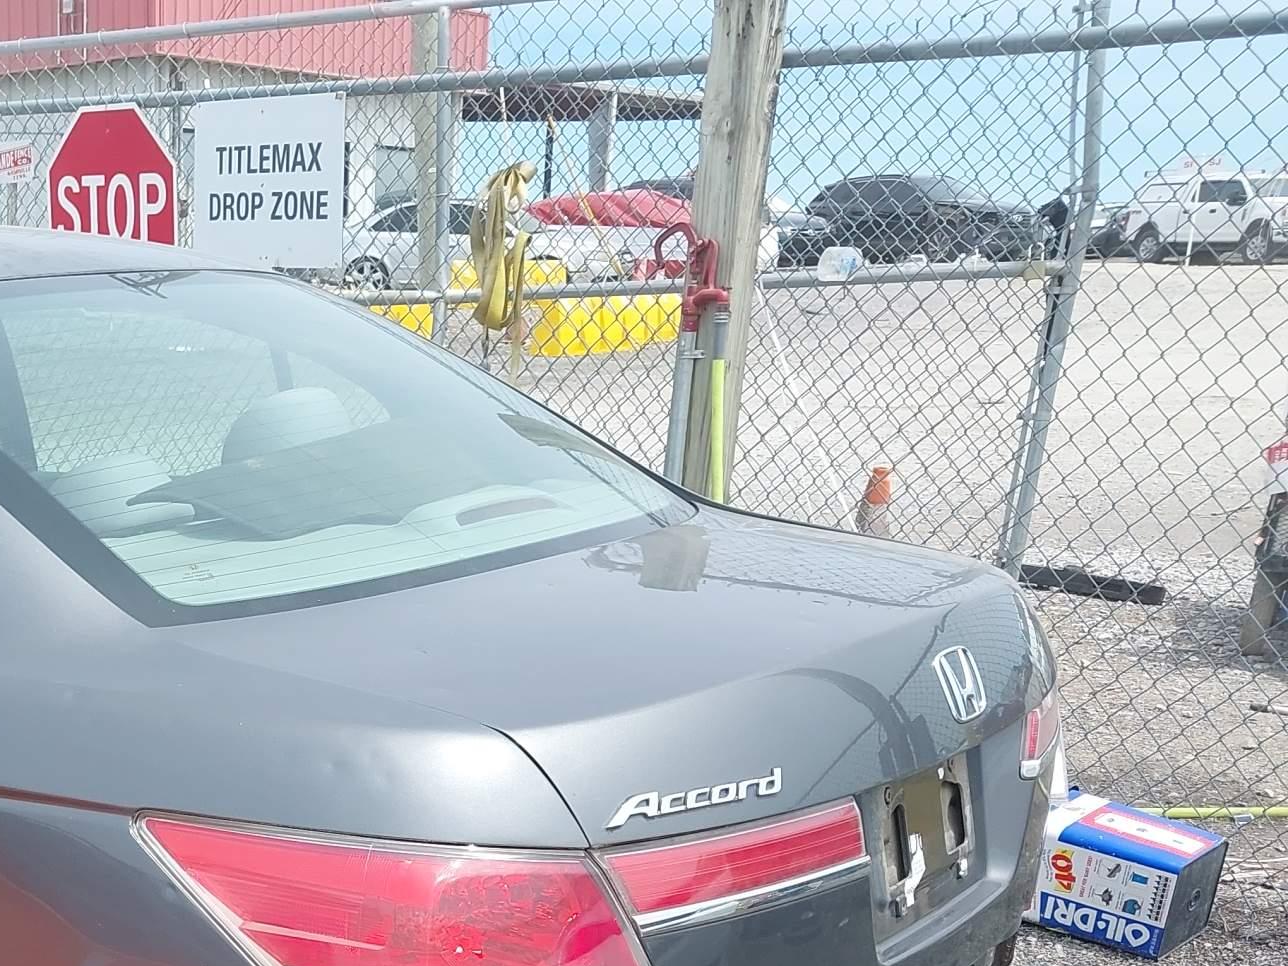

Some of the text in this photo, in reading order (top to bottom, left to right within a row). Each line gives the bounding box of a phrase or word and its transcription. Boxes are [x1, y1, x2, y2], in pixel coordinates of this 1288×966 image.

[215, 142, 322, 175] TITLEMAX
[57, 173, 167, 241] STOP
[209, 190, 329, 221] DROP ZONE
[603, 767, 782, 830] Accord
